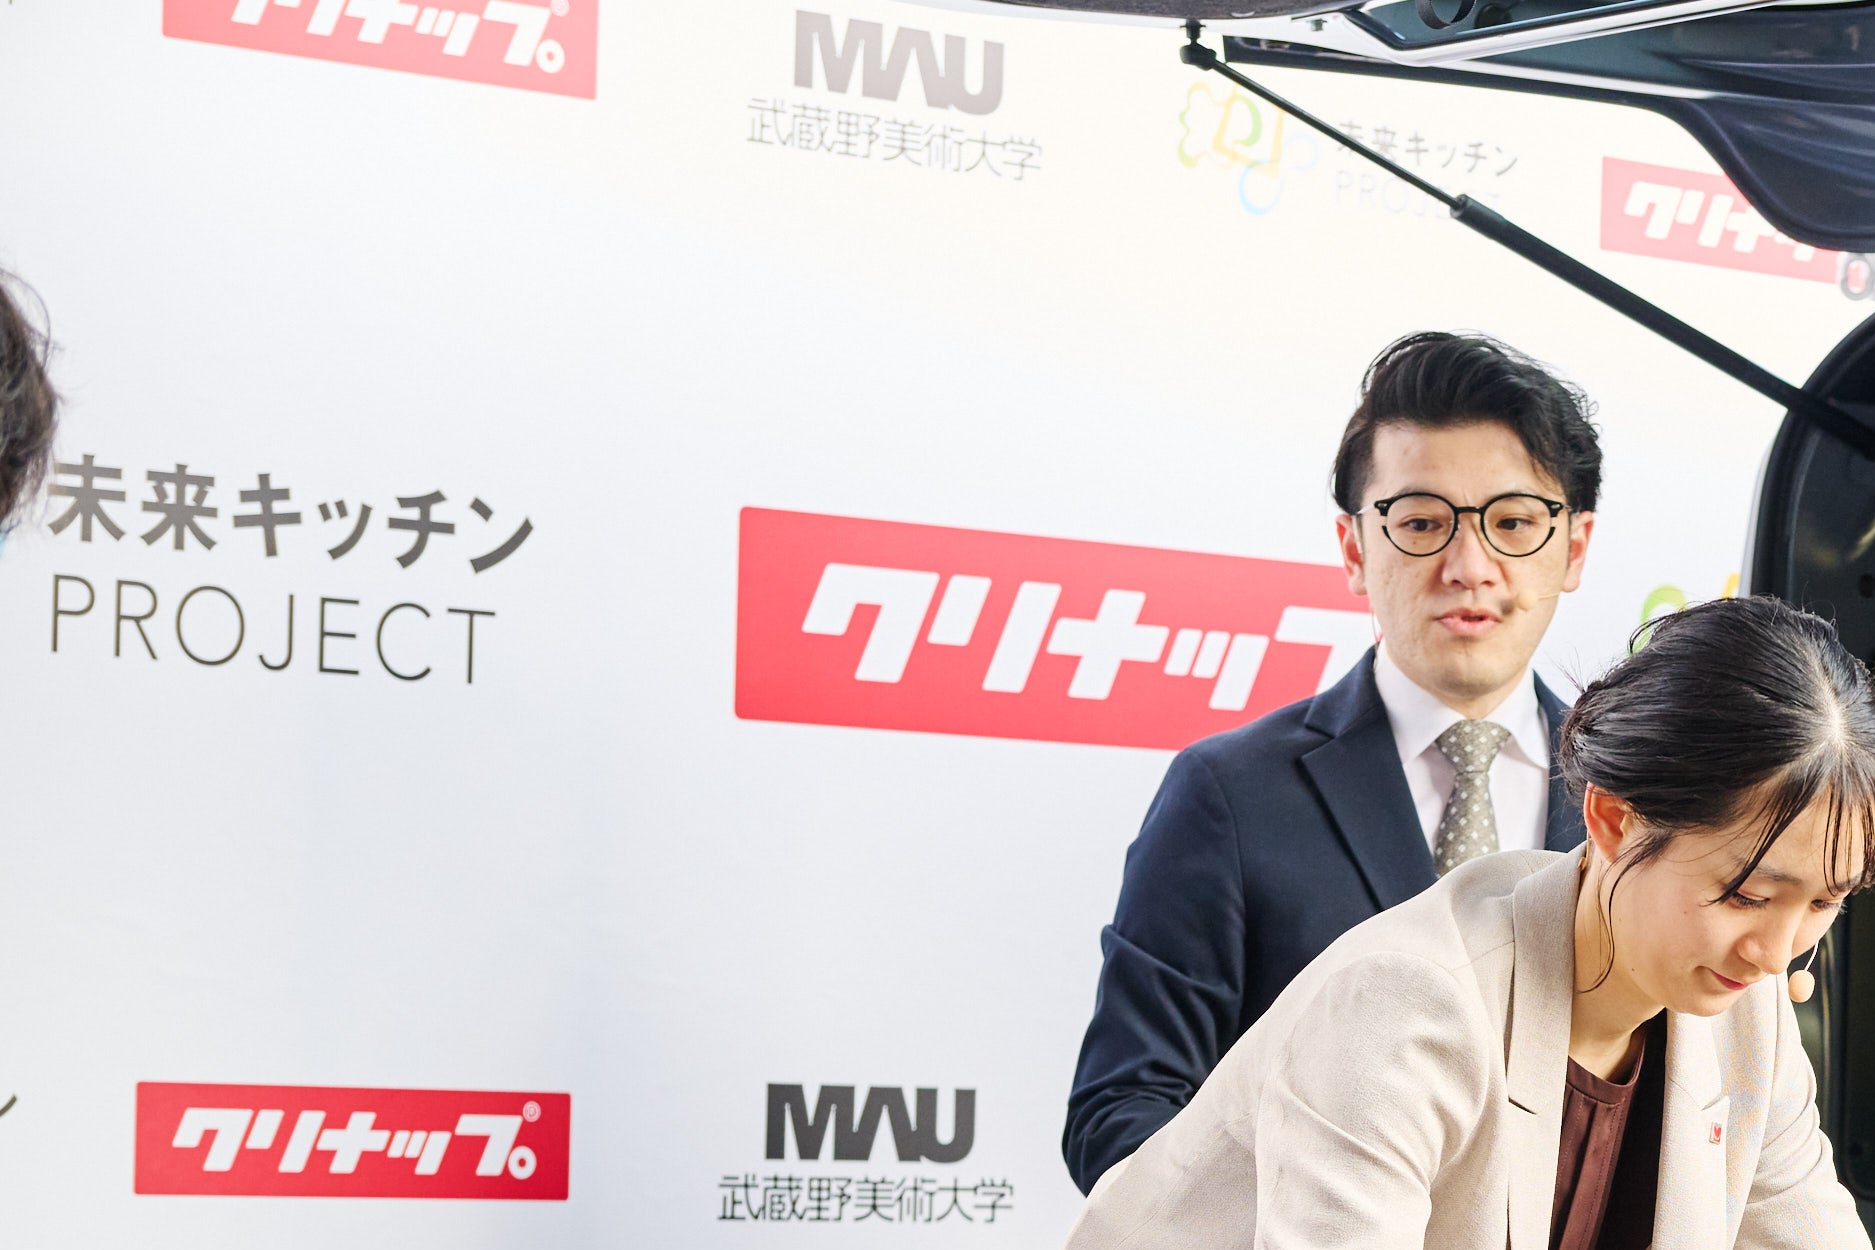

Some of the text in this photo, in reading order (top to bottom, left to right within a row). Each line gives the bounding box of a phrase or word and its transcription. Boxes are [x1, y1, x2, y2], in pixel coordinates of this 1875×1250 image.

[793, 11, 1004, 117] MAU
[746, 97, 1043, 183] 武蔵野美術大学
[48, 454, 534, 573] 未来キッチン
[52, 574, 496, 685] PROJECT
[765, 1083, 976, 1164] MAU
[717, 1173, 1014, 1223] 武蔵野美術大学
